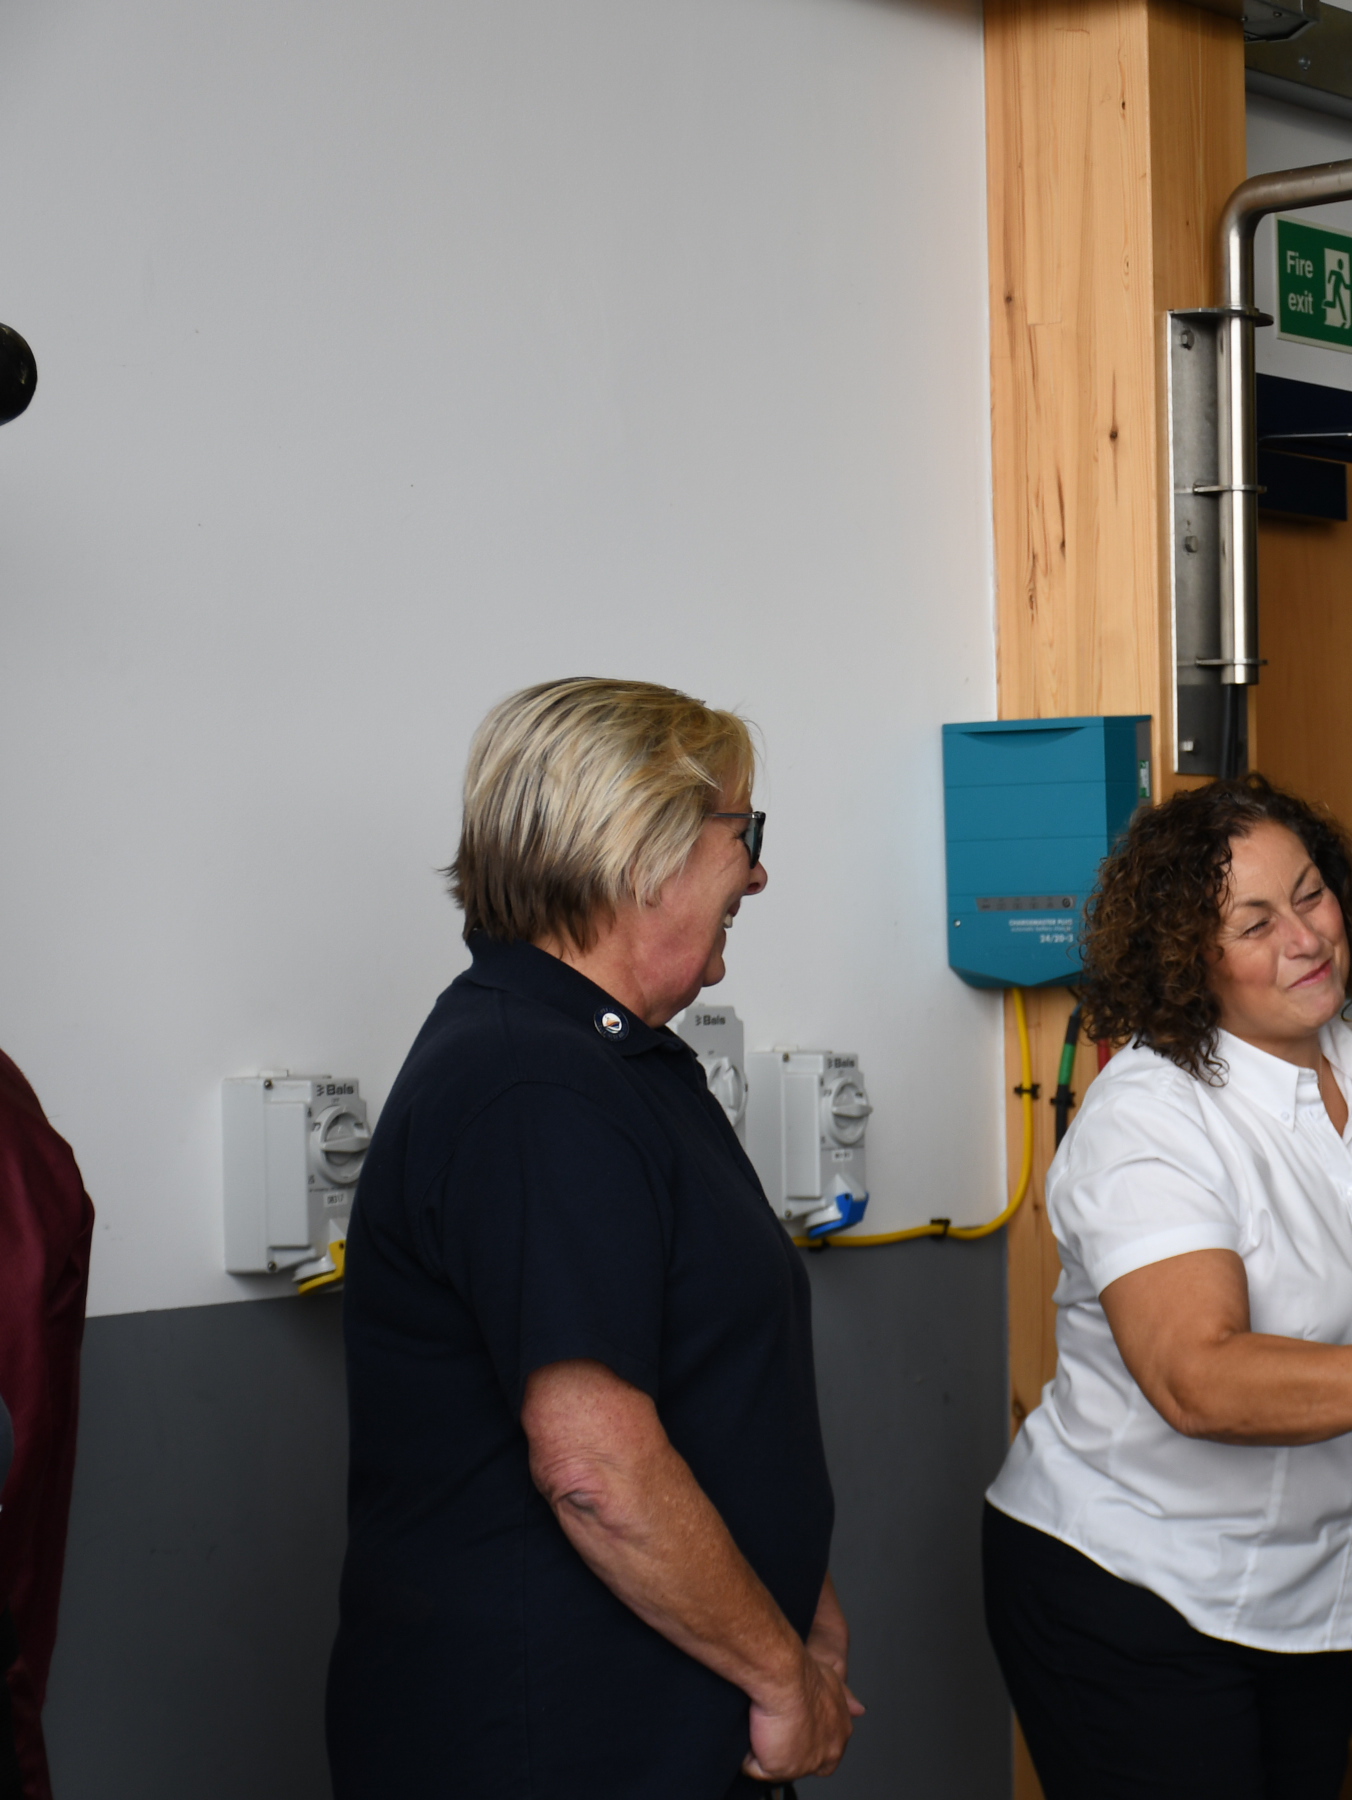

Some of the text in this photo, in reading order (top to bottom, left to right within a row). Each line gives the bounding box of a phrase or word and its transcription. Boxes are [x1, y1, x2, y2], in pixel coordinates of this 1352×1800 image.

[1286, 250, 1314, 279] Fire
[1287, 290, 1314, 315] exit
[703, 1015, 726, 1026] Bals
[834, 1058, 855, 1068] Bals
[326, 1083, 354, 1096] Bals
